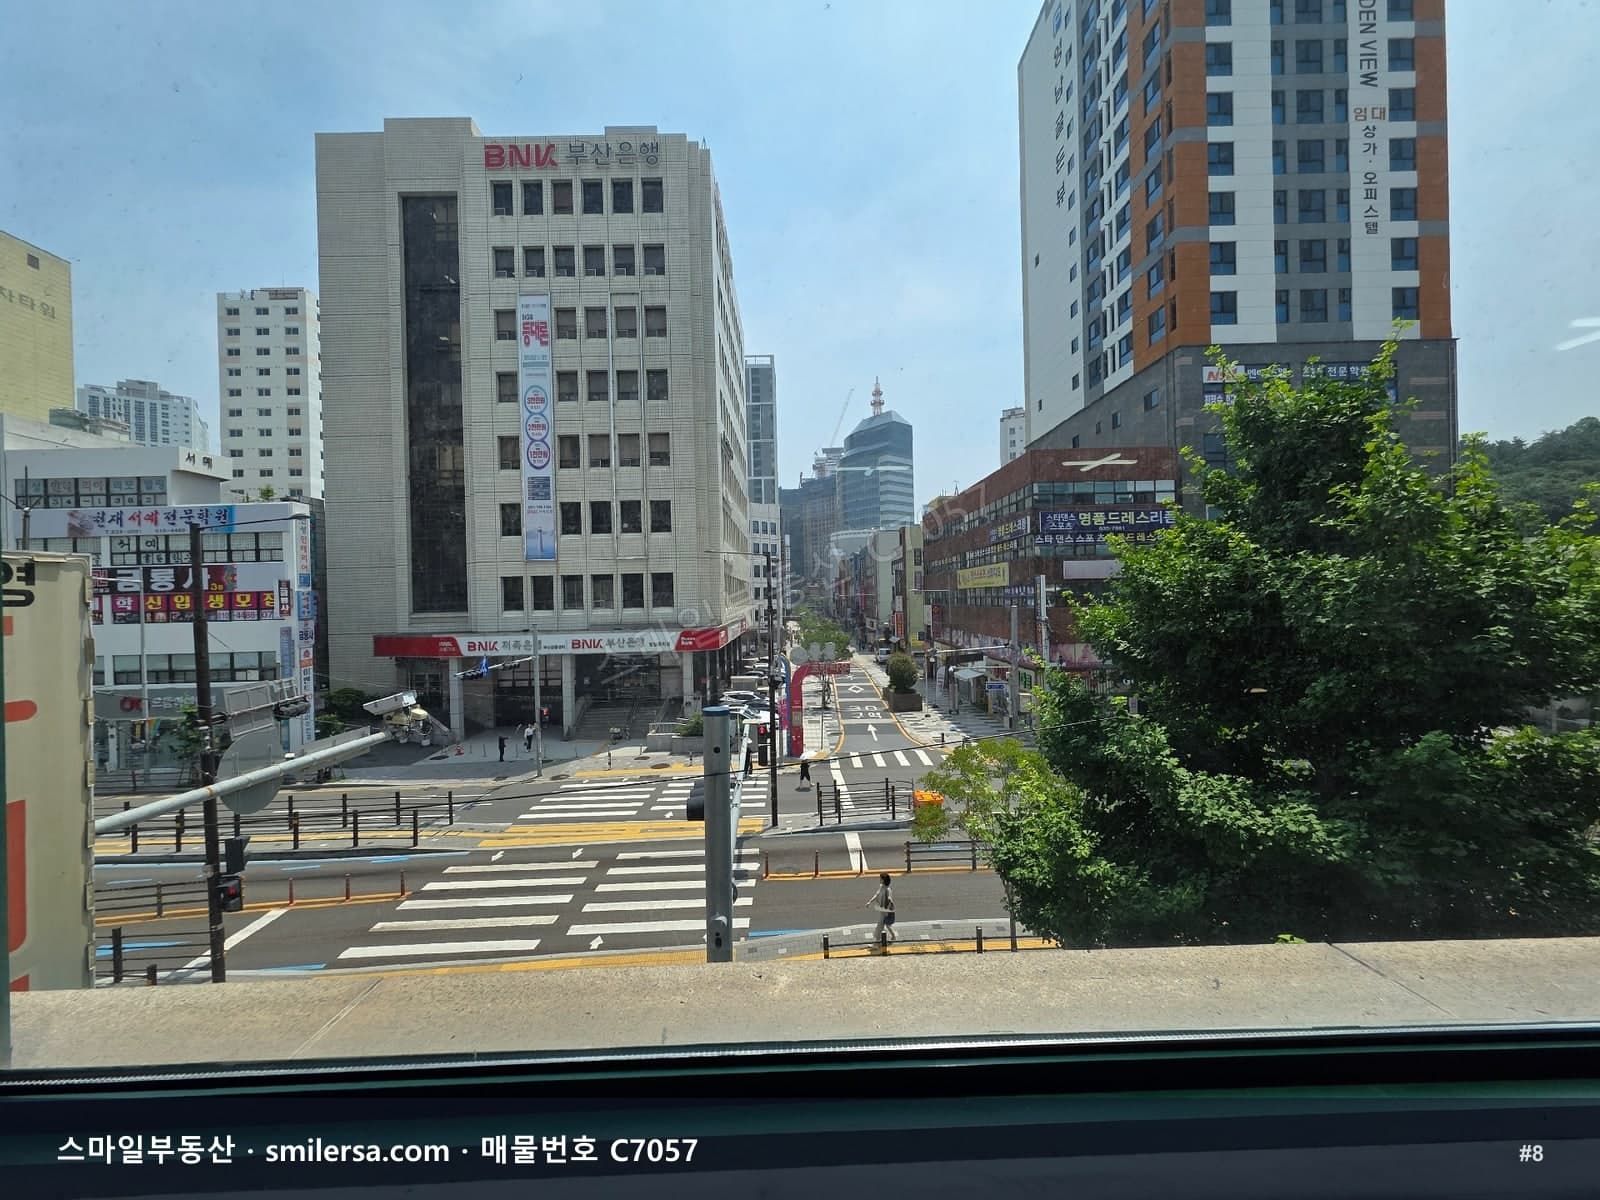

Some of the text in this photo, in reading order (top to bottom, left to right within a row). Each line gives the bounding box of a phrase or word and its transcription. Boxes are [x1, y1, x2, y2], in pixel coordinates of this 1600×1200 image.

[1359, 40, 1378, 88] VIEW
[1353, 106, 1387, 122] 임대
[484, 141, 659, 168] BNK 부산은행
[128, 510, 160, 528] 서예
[163, 508, 229, 526] 전문학원
[467, 641, 499, 652] BNK
[571, 638, 603, 650] BNK
